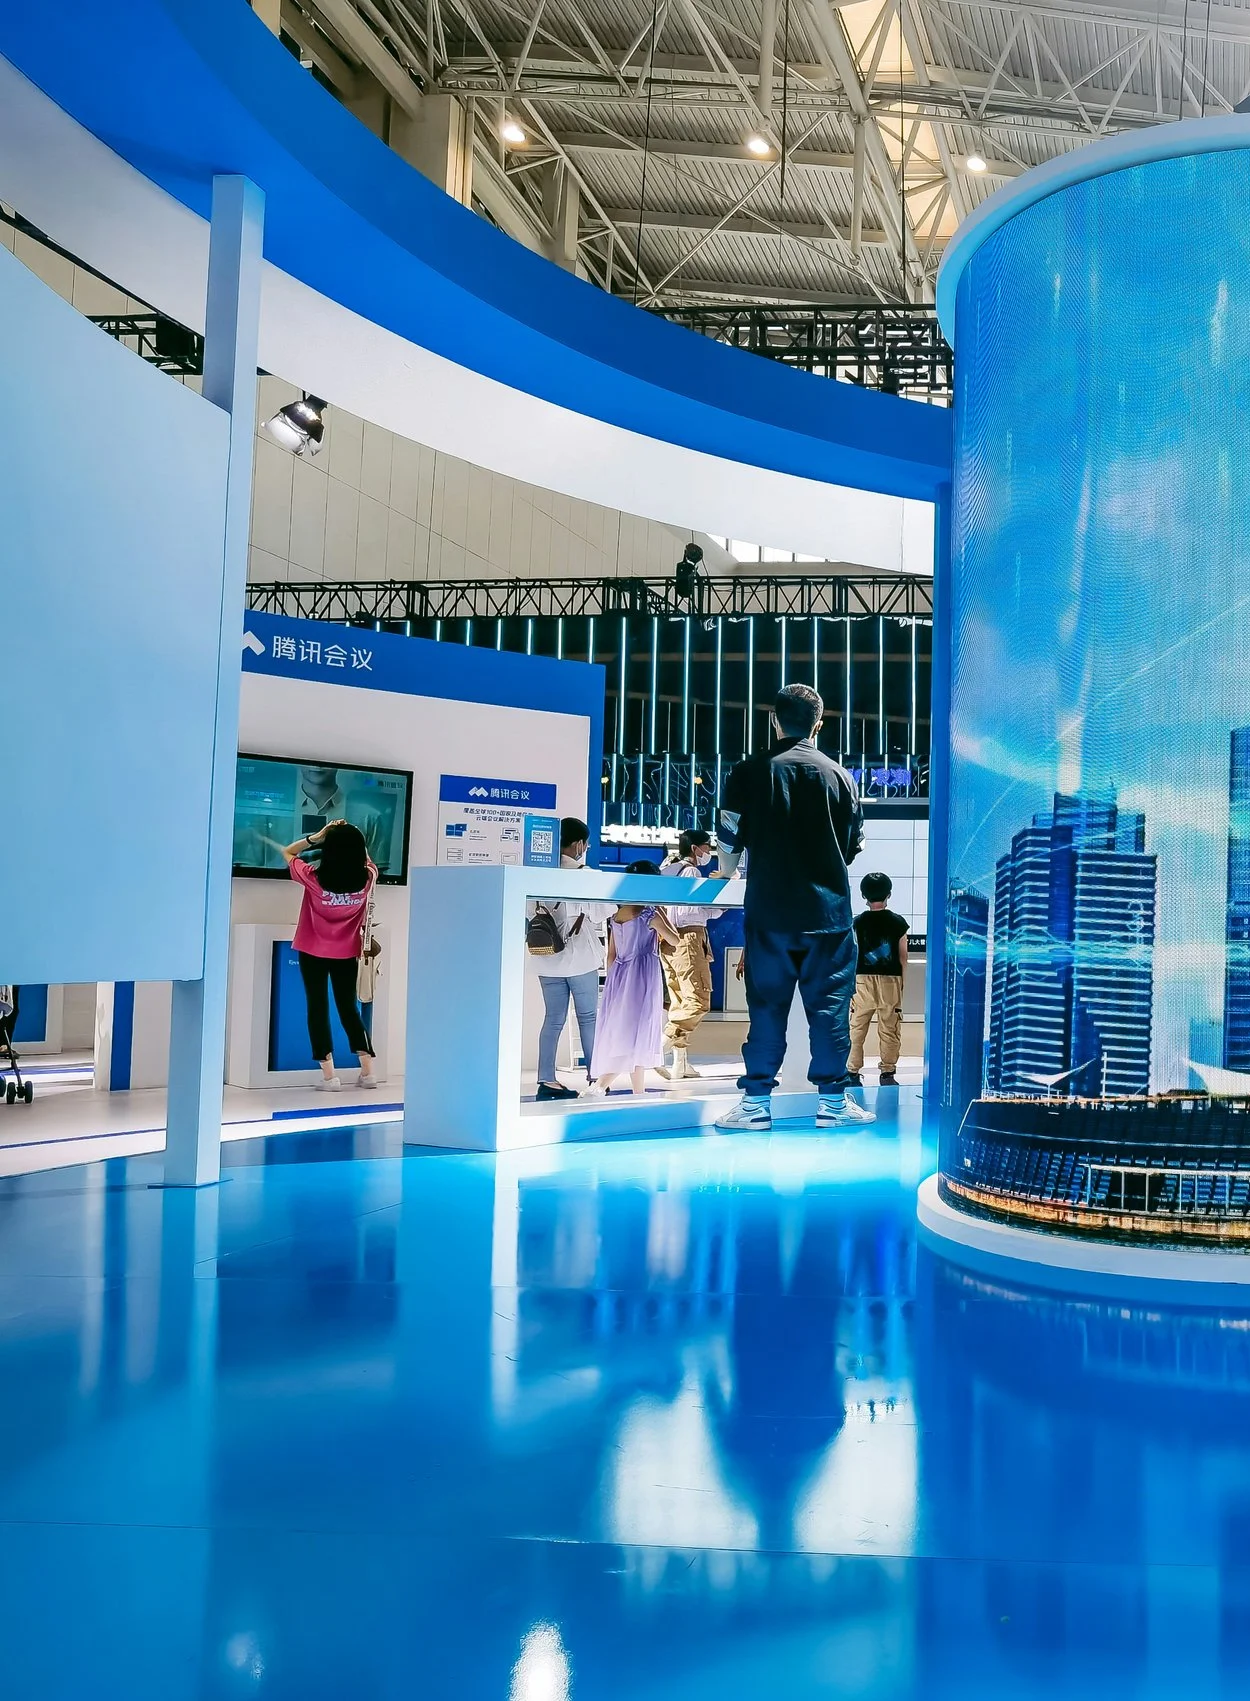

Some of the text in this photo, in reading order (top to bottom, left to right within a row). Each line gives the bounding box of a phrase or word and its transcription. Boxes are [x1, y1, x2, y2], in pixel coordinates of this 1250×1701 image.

[272, 635, 373, 671] 腾讯会议
[490, 788, 530, 801] 腾讯会议
